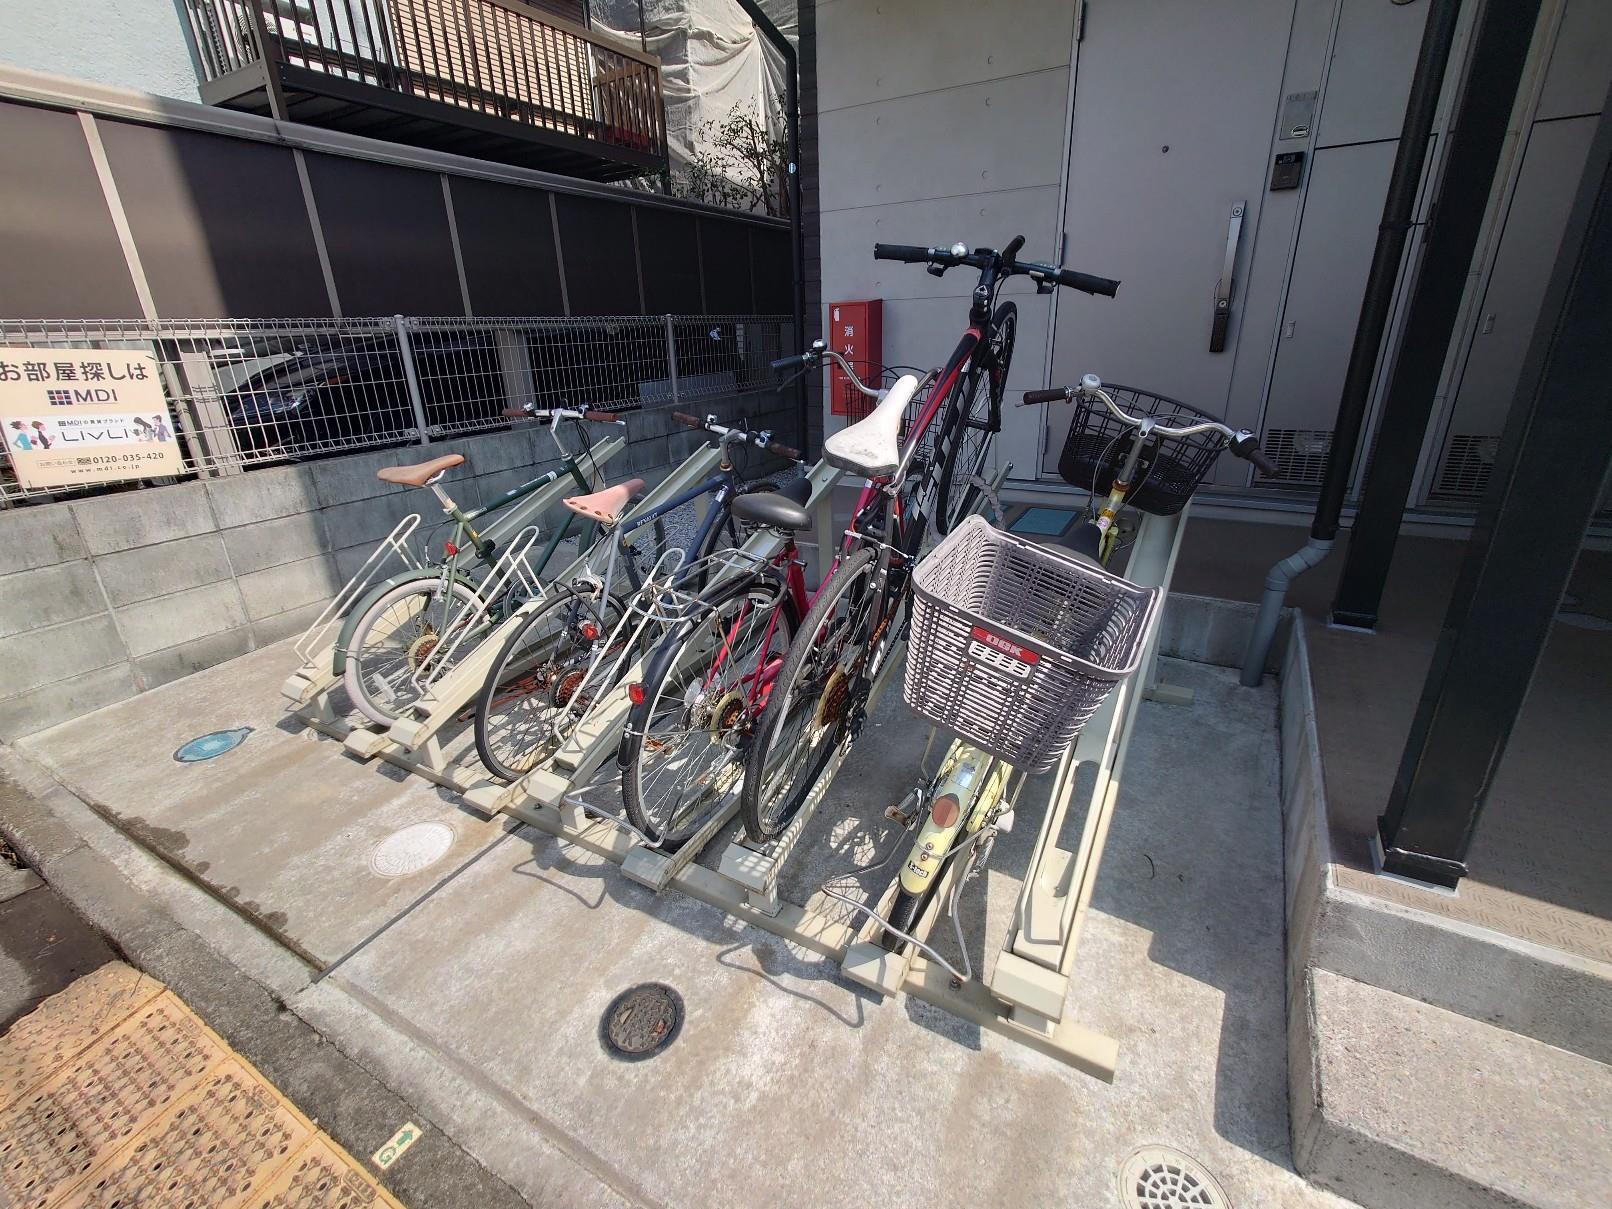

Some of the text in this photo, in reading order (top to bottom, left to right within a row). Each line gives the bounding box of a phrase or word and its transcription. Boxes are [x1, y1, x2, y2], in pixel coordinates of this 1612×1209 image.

[0, 360, 149, 382] お部屋探しは
[73, 388, 119, 403] MDI
[61, 428, 129, 442] LIVLI
[92, 452, 164, 465] 0120-035-420
